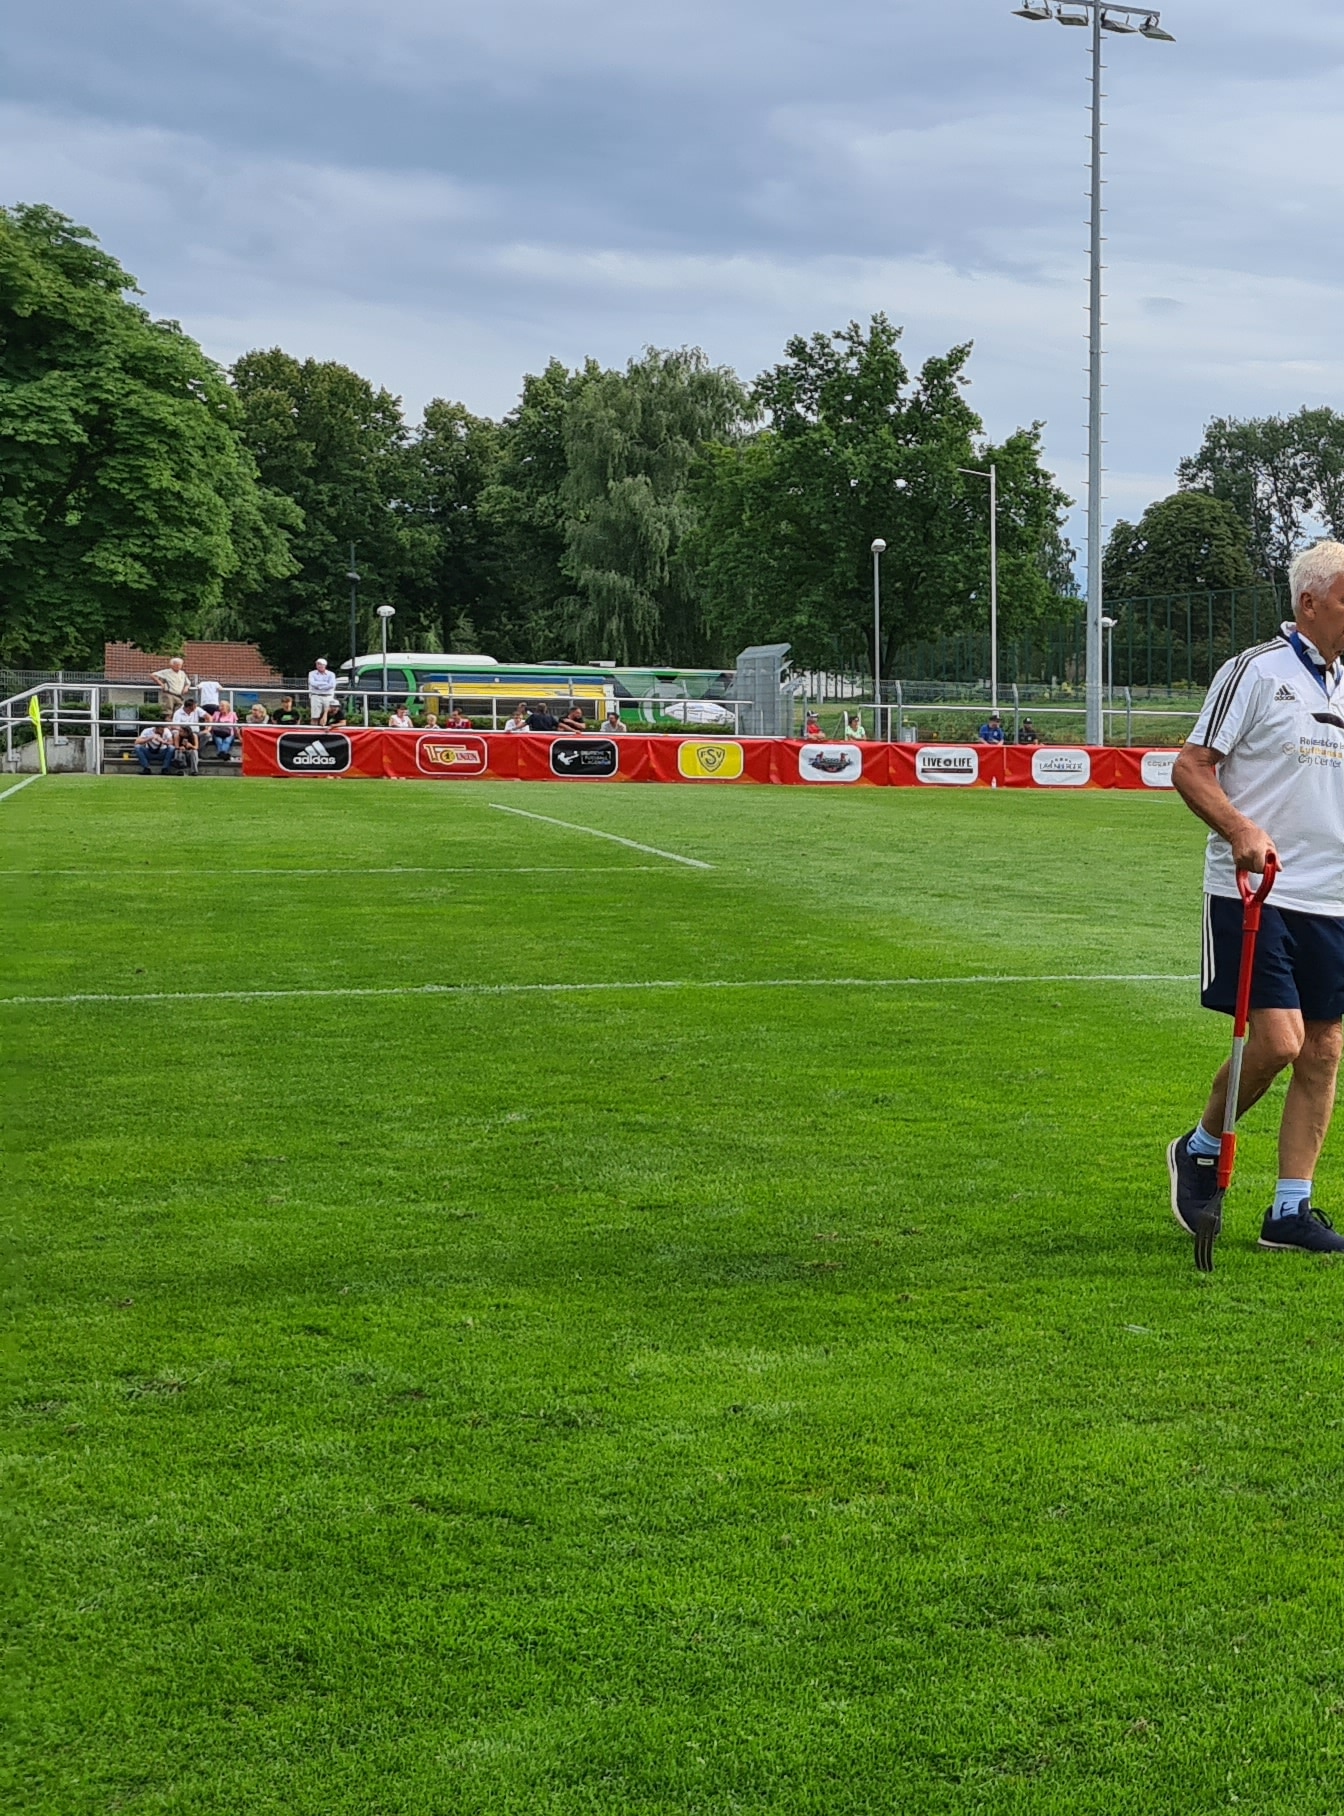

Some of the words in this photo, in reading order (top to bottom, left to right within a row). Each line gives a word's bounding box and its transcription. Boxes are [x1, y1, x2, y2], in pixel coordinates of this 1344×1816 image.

[293, 754, 336, 764] adidas
[923, 757, 942, 767] LIVE
[954, 758, 973, 767] LIFE
